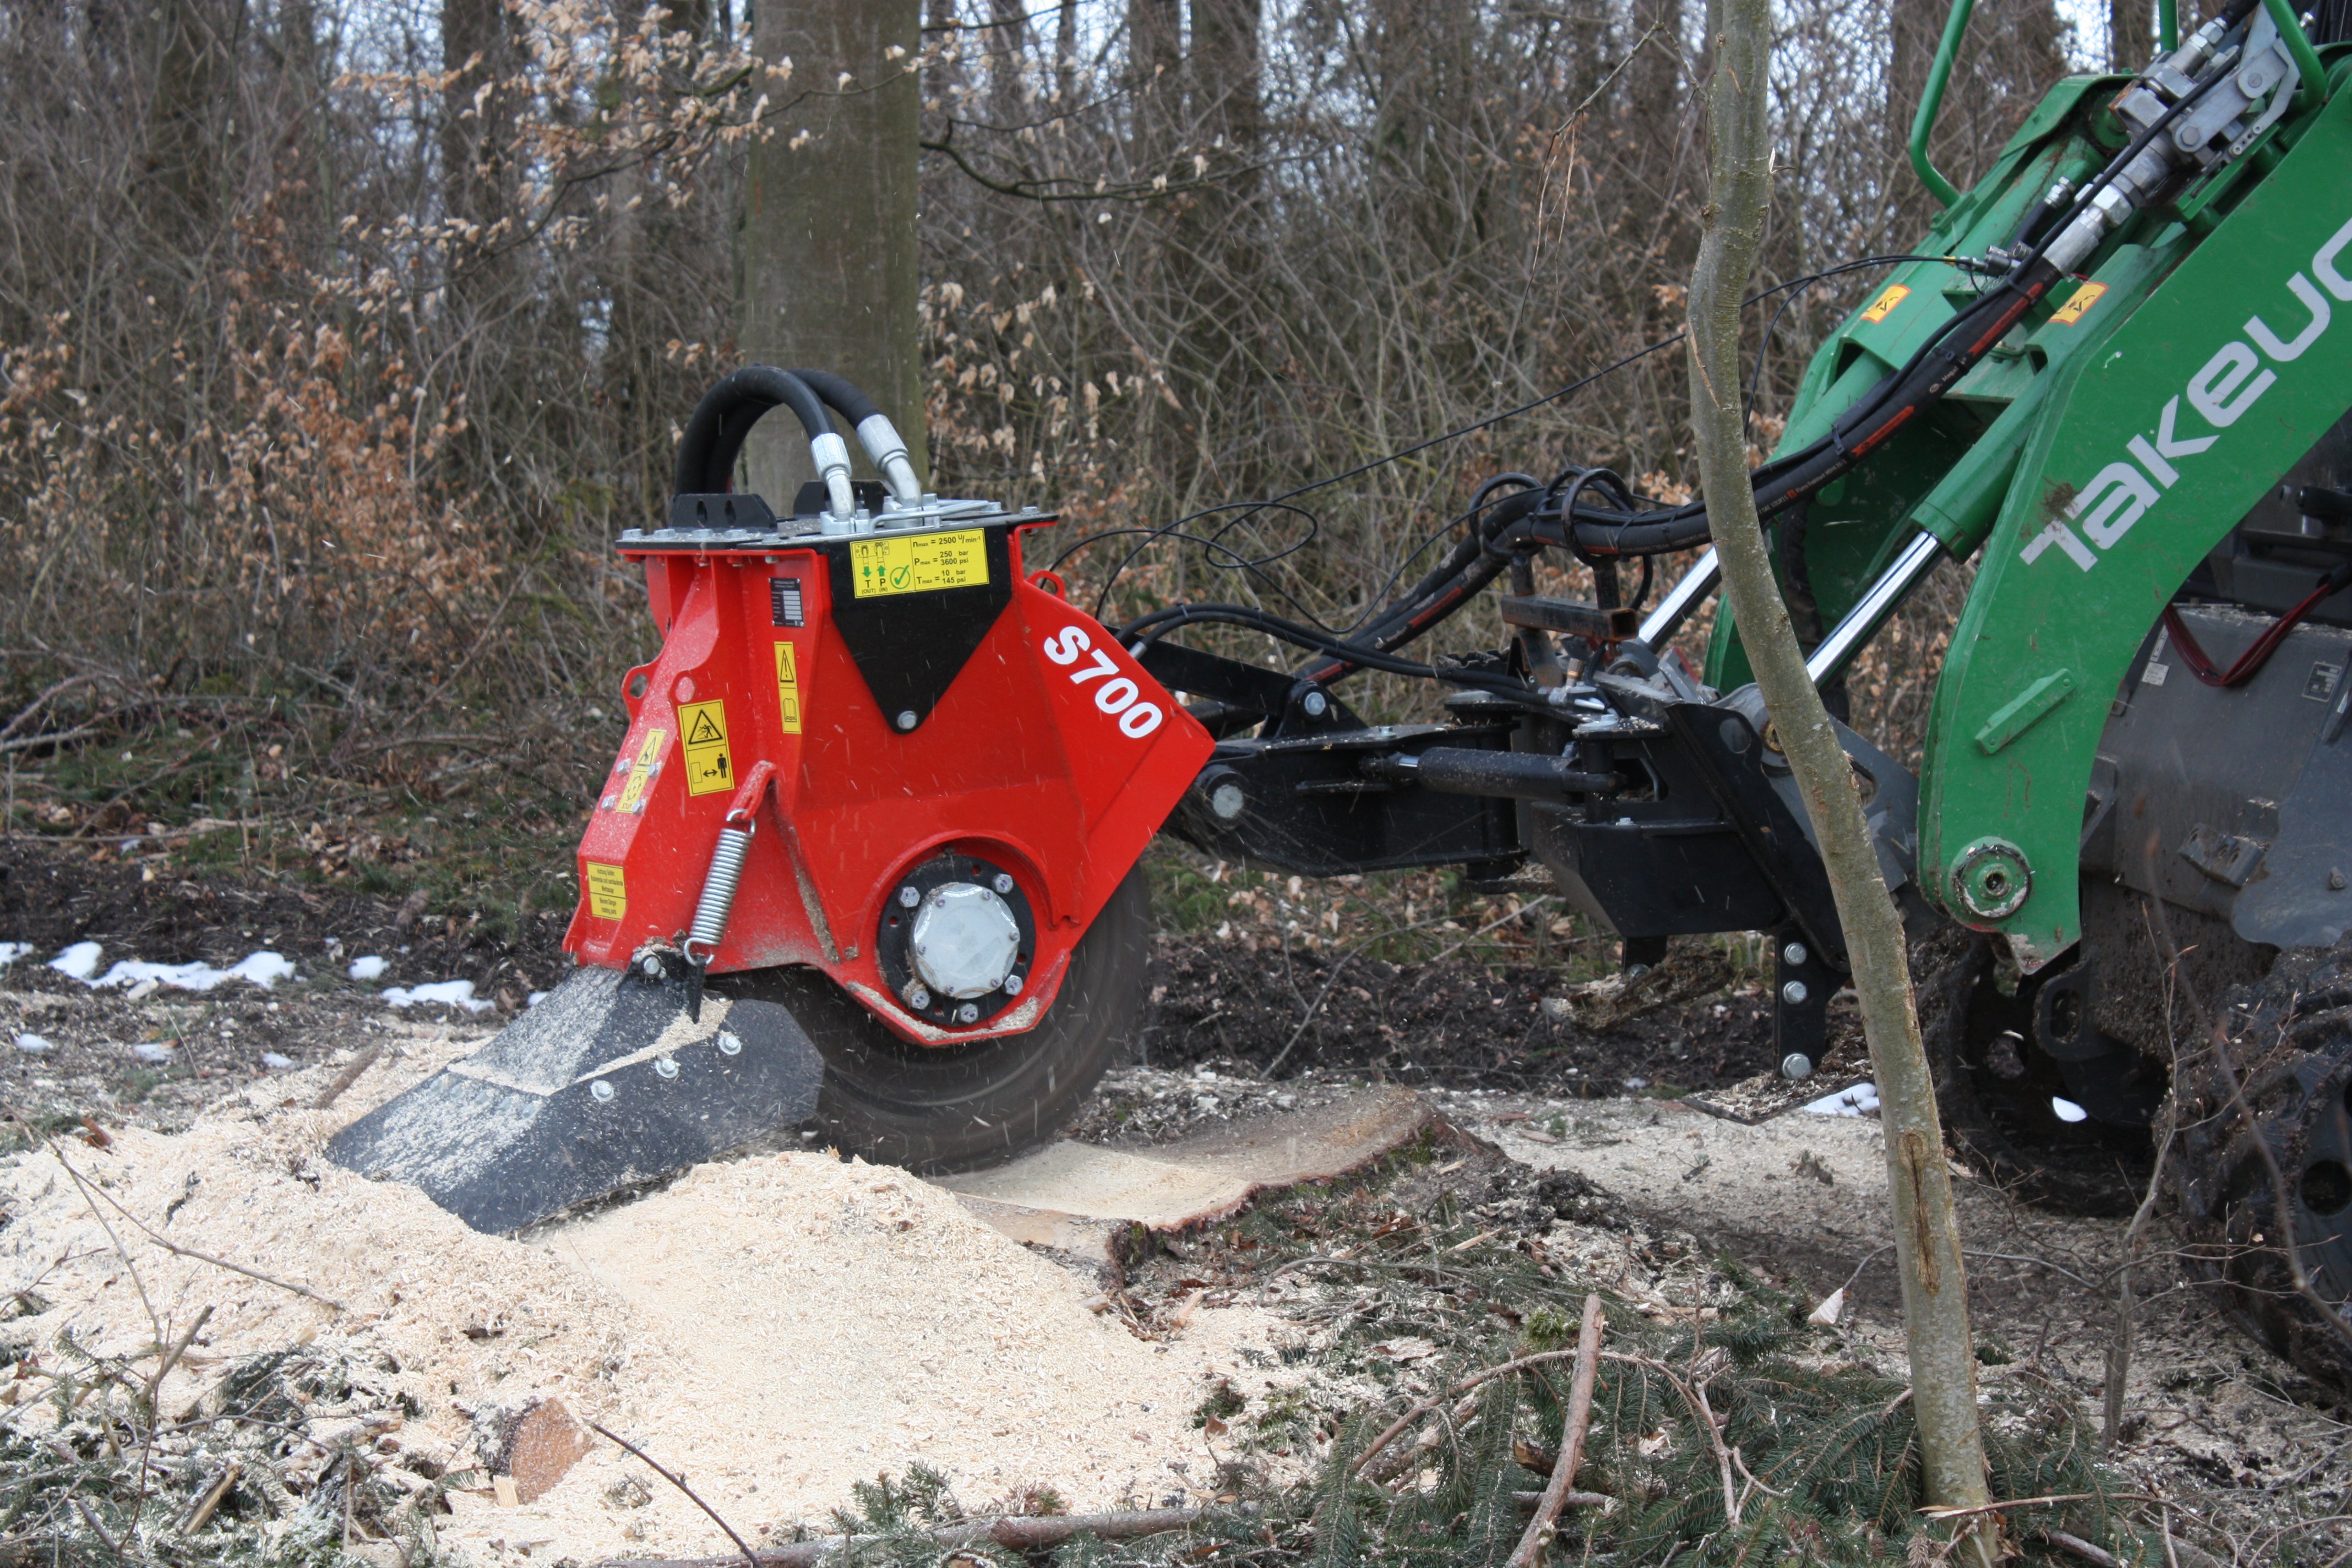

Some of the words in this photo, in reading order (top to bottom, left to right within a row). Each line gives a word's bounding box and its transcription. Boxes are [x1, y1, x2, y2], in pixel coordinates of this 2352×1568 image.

[865, 580, 870, 588] T
[880, 578, 886, 586] P
[1044, 626, 1163, 738] S700
